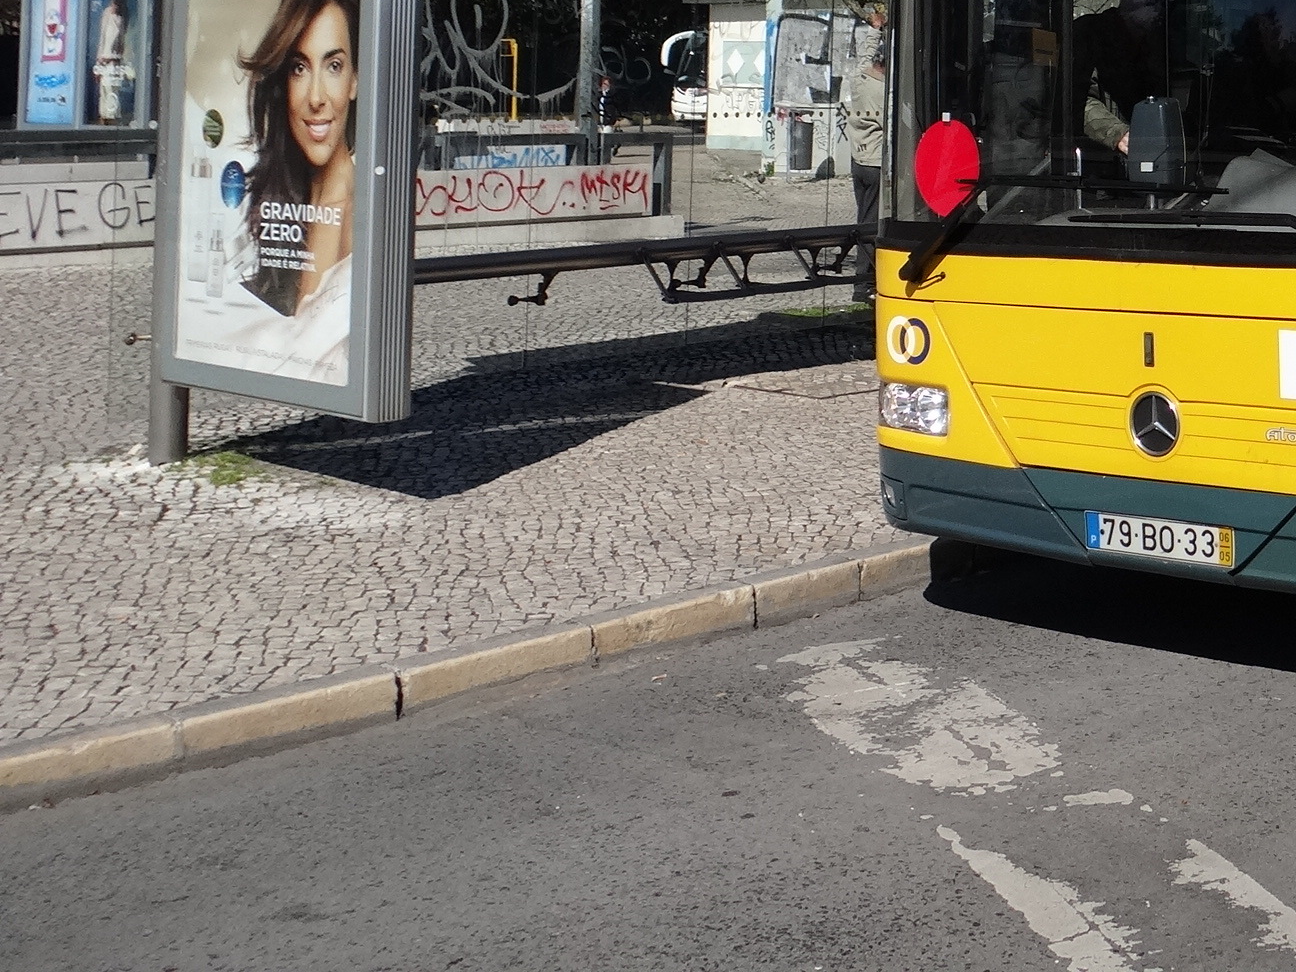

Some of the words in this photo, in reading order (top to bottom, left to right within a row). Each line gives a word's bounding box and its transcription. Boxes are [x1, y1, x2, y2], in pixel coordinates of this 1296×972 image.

[260, 201, 342, 226] GRAVIDADE
[260, 223, 302, 243] ZERO
[1090, 535, 1097, 544] P
[1218, 532, 1230, 543] 06
[1218, 551, 1231, 562] 05
